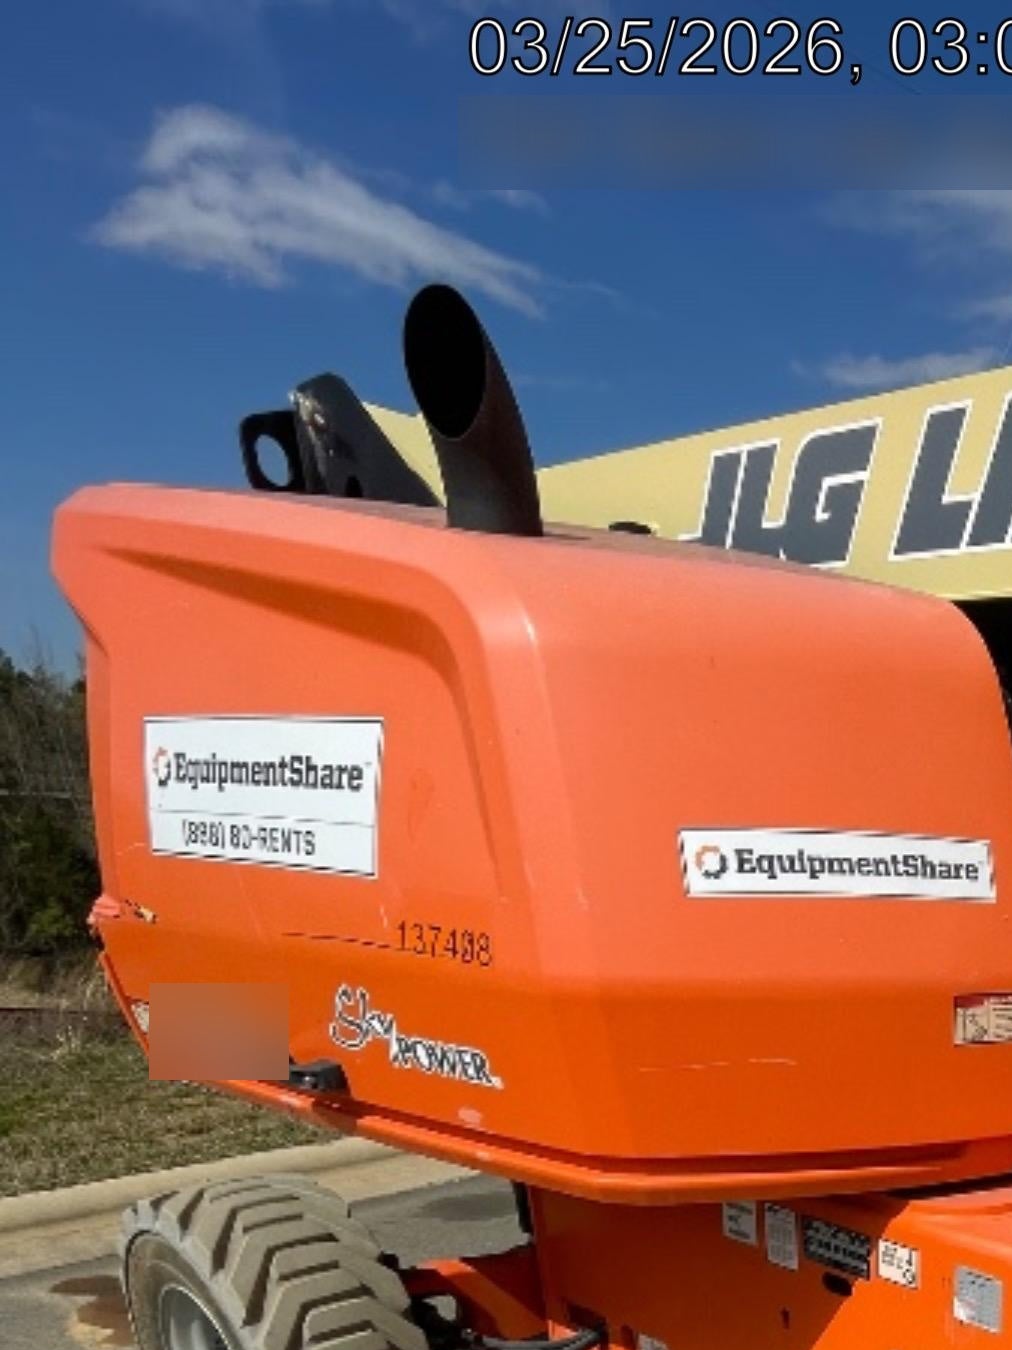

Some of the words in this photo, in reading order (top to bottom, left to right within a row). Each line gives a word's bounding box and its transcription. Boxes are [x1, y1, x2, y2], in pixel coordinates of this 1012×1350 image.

[680, 417, 882, 569] JLG
[173, 752, 365, 793] EquipmentShare
[735, 848, 980, 882] EquipmentShare
